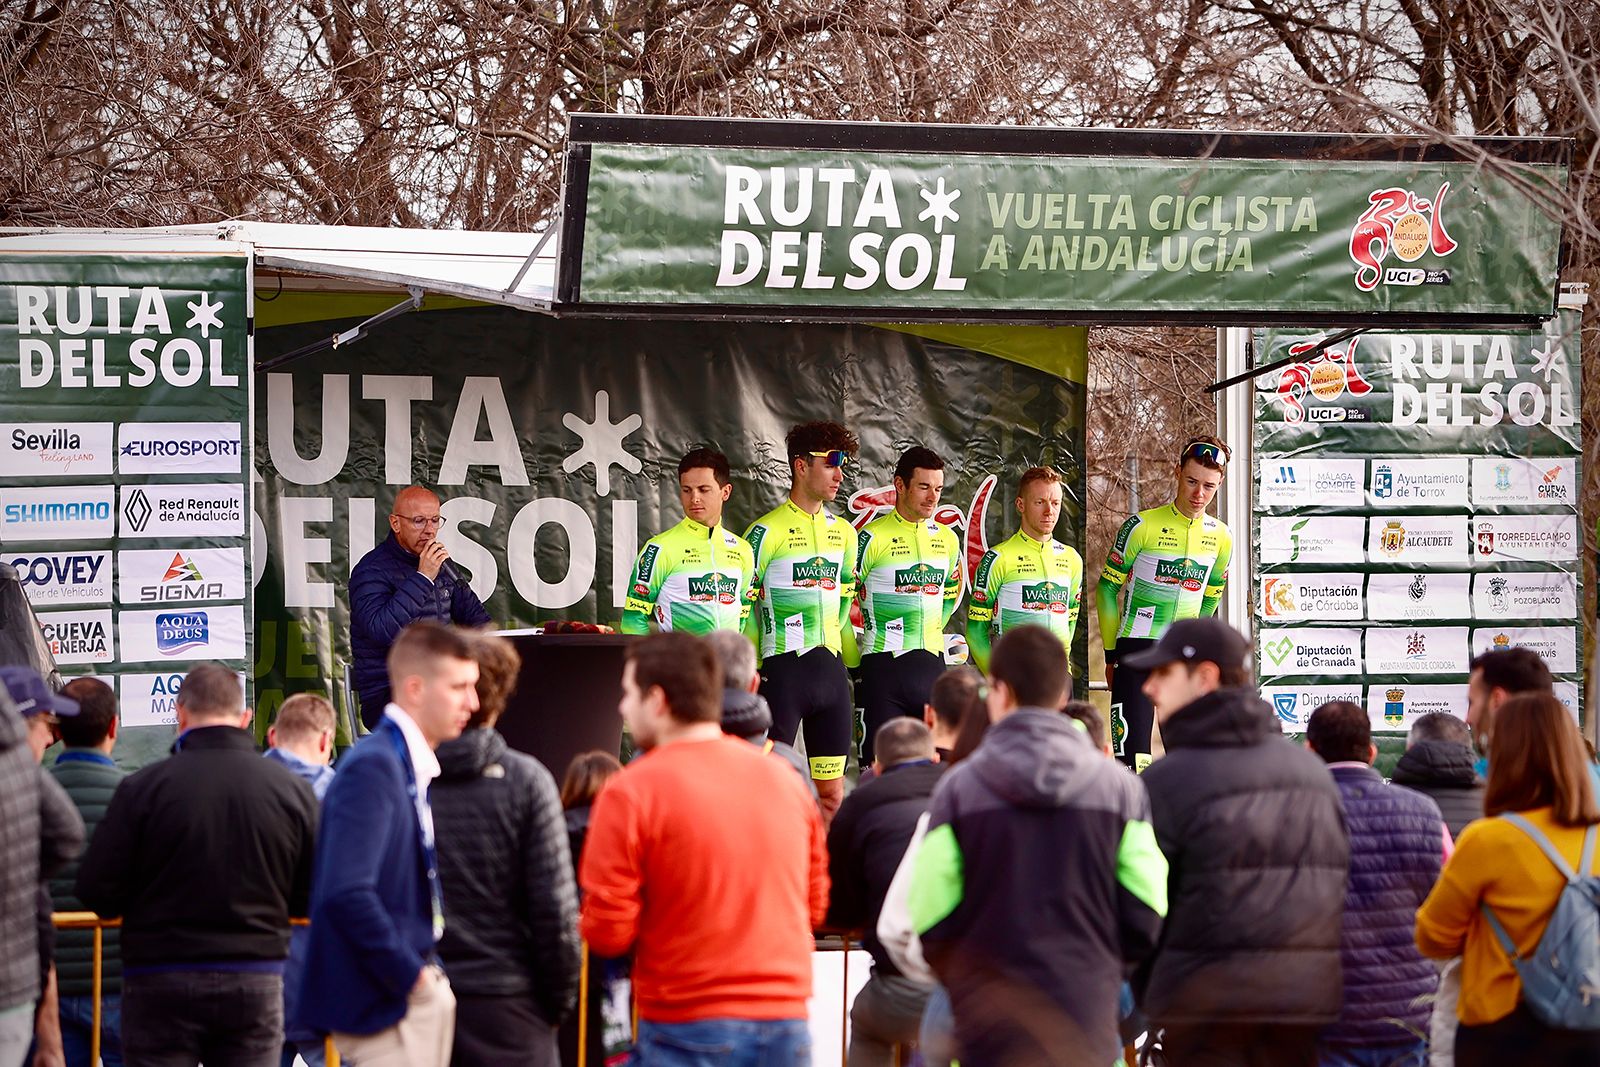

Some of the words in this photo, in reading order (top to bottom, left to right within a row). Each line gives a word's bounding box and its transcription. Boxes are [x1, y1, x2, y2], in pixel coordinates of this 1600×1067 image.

[723, 165, 902, 229] RUTA
[987, 191, 1137, 231] VUELTA
[1147, 194, 1318, 233] CICLISTA
[979, 234, 1008, 271] A
[1018, 228, 1254, 273] ANDALUCÍA
[1387, 271, 1411, 282] UCI
[16, 286, 173, 335] RUTA
[1392, 336, 1517, 379] RUTA
[1311, 410, 1332, 419] UCI
[254, 373, 531, 486] UTA
[11, 428, 81, 450] Sevilla
[131, 440, 241, 457] EUROSPORT
[1317, 472, 1353, 480] MÁLAGA
[1397, 473, 1465, 486] Ayuntamiento
[1315, 481, 1356, 490] COMPITE
[1397, 487, 1410, 497] de
[1413, 486, 1446, 498] Torrox
[159, 498, 184, 510] Red
[188, 497, 239, 509] Renault
[5, 502, 110, 523] SHIMANO
[159, 510, 175, 522] de
[177, 508, 240, 522] Andalucía
[1115, 515, 1137, 549] WAGNER
[1497, 532, 1571, 541] TORREDELCAMPO
[1406, 537, 1453, 547] ALCAUDETE
[641, 546, 656, 580] WAGNER
[978, 552, 995, 586] WAGNER
[10, 555, 105, 587] COVEY
[796, 566, 836, 578] WAGNER
[1161, 564, 1205, 580] WAGNER
[899, 573, 943, 584] WAGNER
[27, 589, 45, 599] uiler
[48, 588, 59, 598] de
[141, 583, 223, 601] SIGMA
[692, 581, 736, 593] WAGNER
[1300, 586, 1358, 599] Diputación
[1026, 589, 1067, 601] WAGNER
[1300, 602, 1313, 611] de
[1316, 599, 1359, 611] Córdoba
[161, 616, 204, 629] AQUA
[43, 622, 107, 642] CUEVA
[163, 628, 203, 640] DEUS
[1296, 645, 1352, 658] Diputación
[1296, 657, 1309, 667] de
[1311, 657, 1356, 668] Granada
[151, 674, 185, 695] AQ
